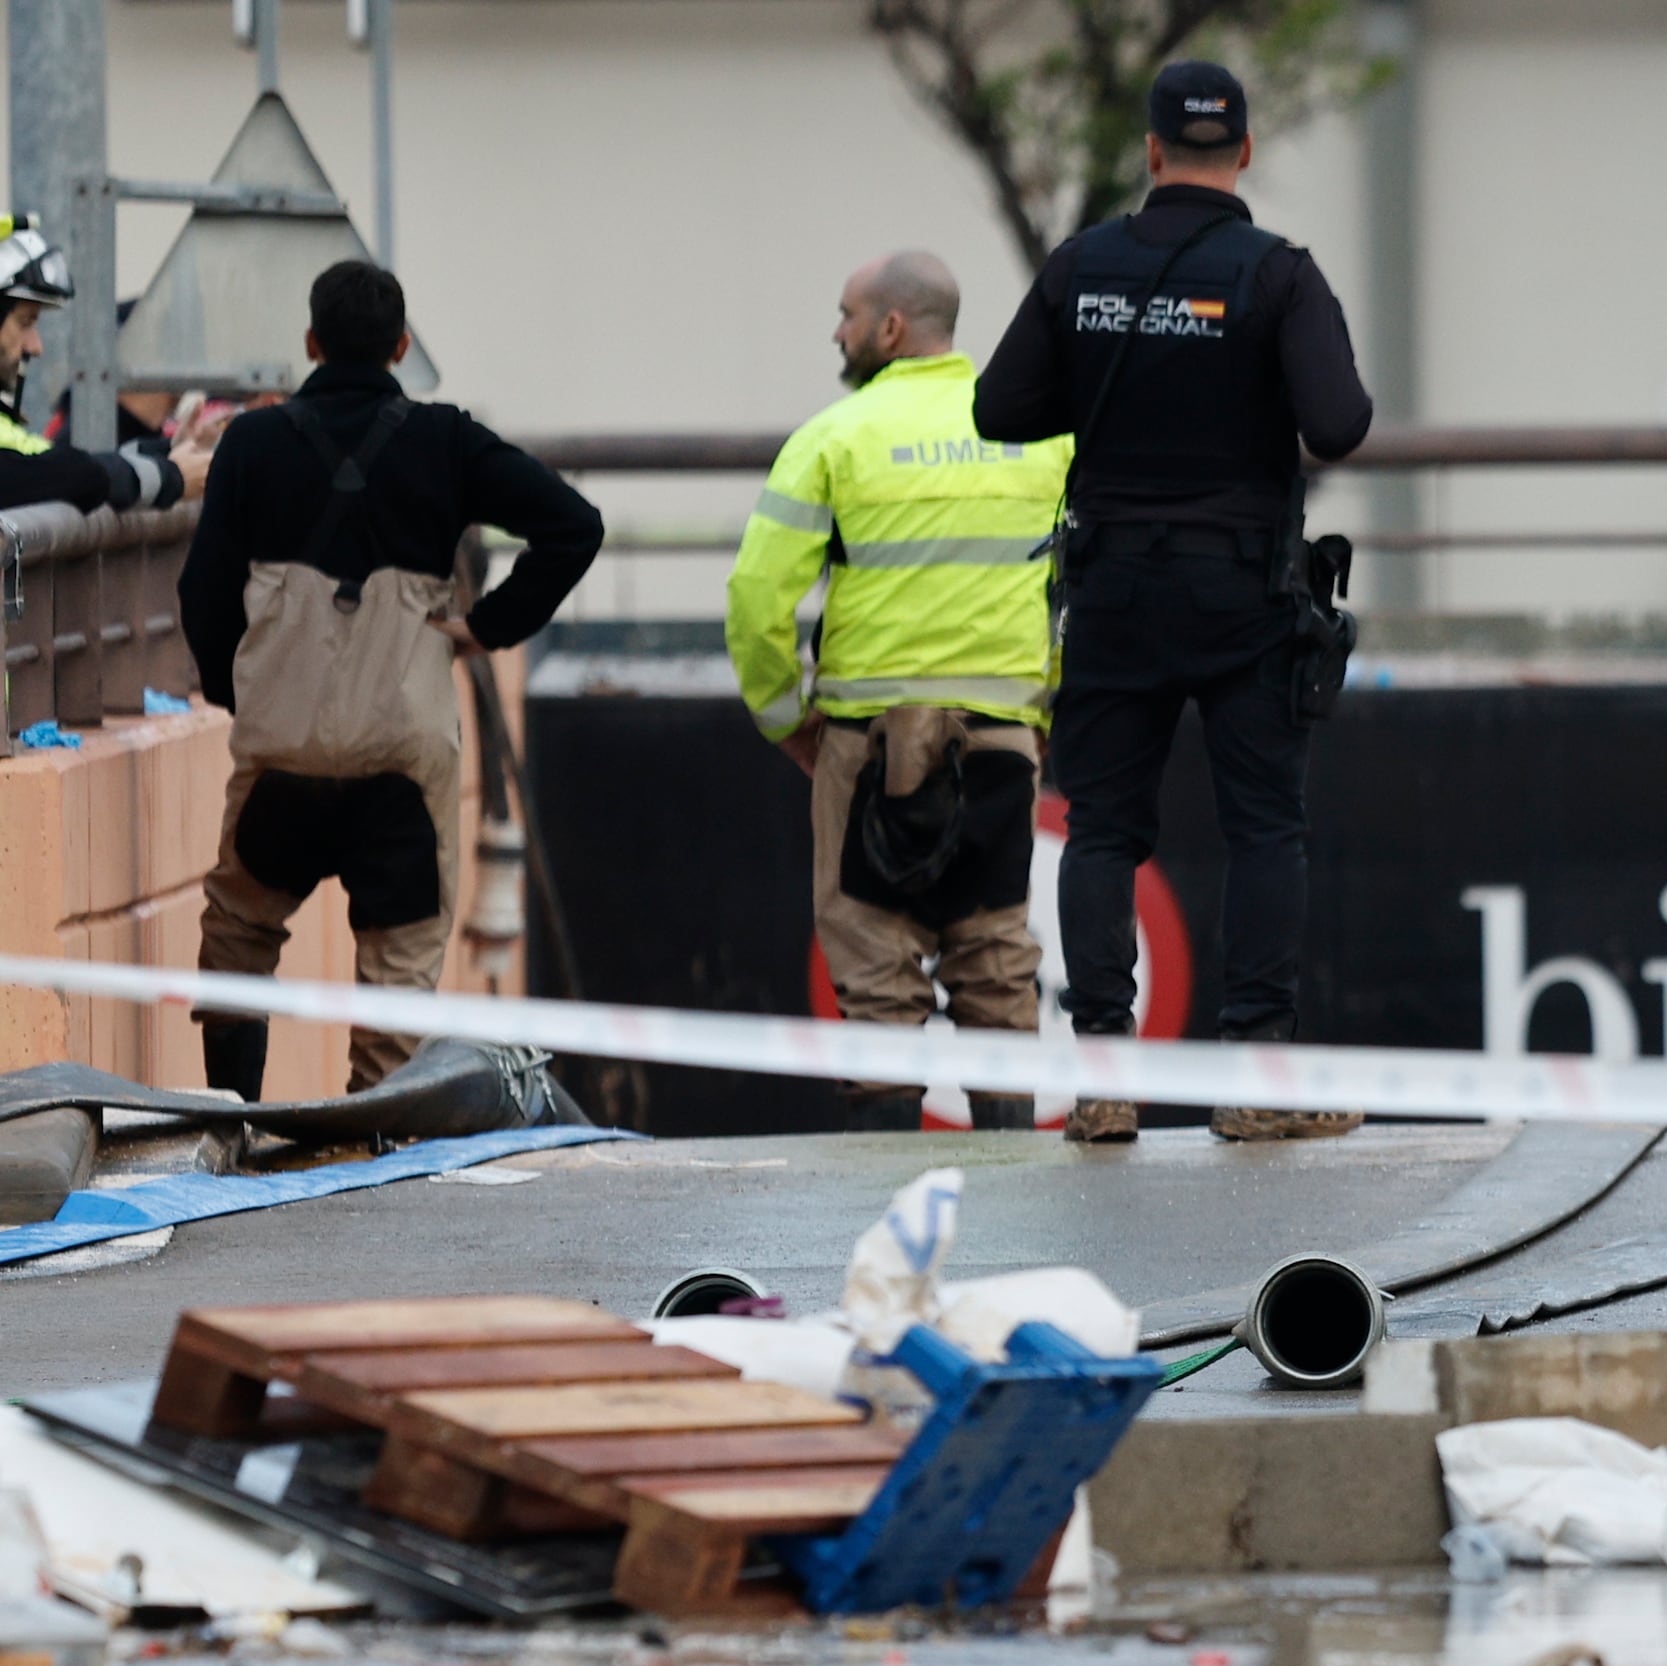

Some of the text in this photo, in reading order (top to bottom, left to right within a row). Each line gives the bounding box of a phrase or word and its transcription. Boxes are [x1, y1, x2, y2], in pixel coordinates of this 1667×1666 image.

[1077, 293, 1192, 317] POLCIA
[1075, 314, 1224, 338] NACONAL
[917, 437, 998, 466] UME
